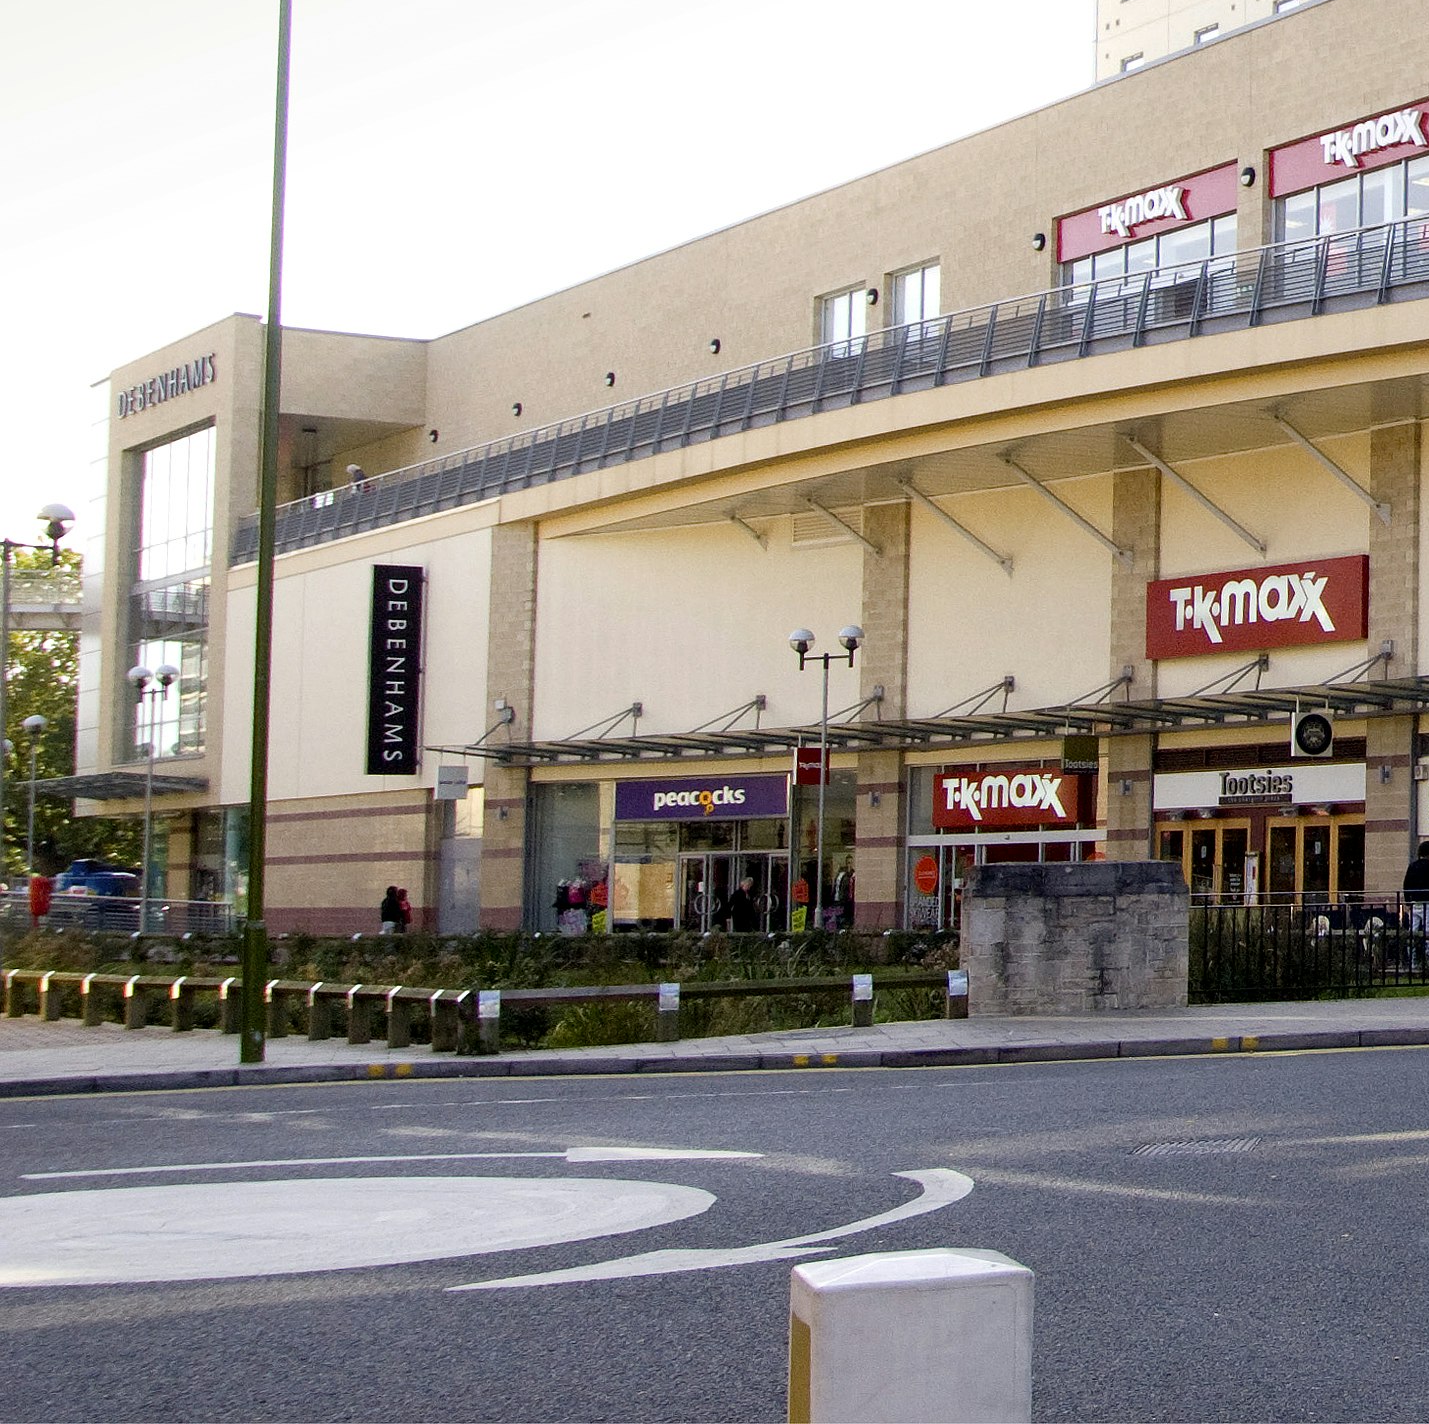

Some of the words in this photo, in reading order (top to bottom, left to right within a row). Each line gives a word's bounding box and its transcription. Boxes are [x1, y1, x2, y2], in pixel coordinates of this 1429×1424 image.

[116, 352, 216, 420] DEBENHAMS
[382, 578, 409, 763] DEBENHAMS
[653, 785, 746, 812] peacocks
[1218, 769, 1294, 796] Tootsies
